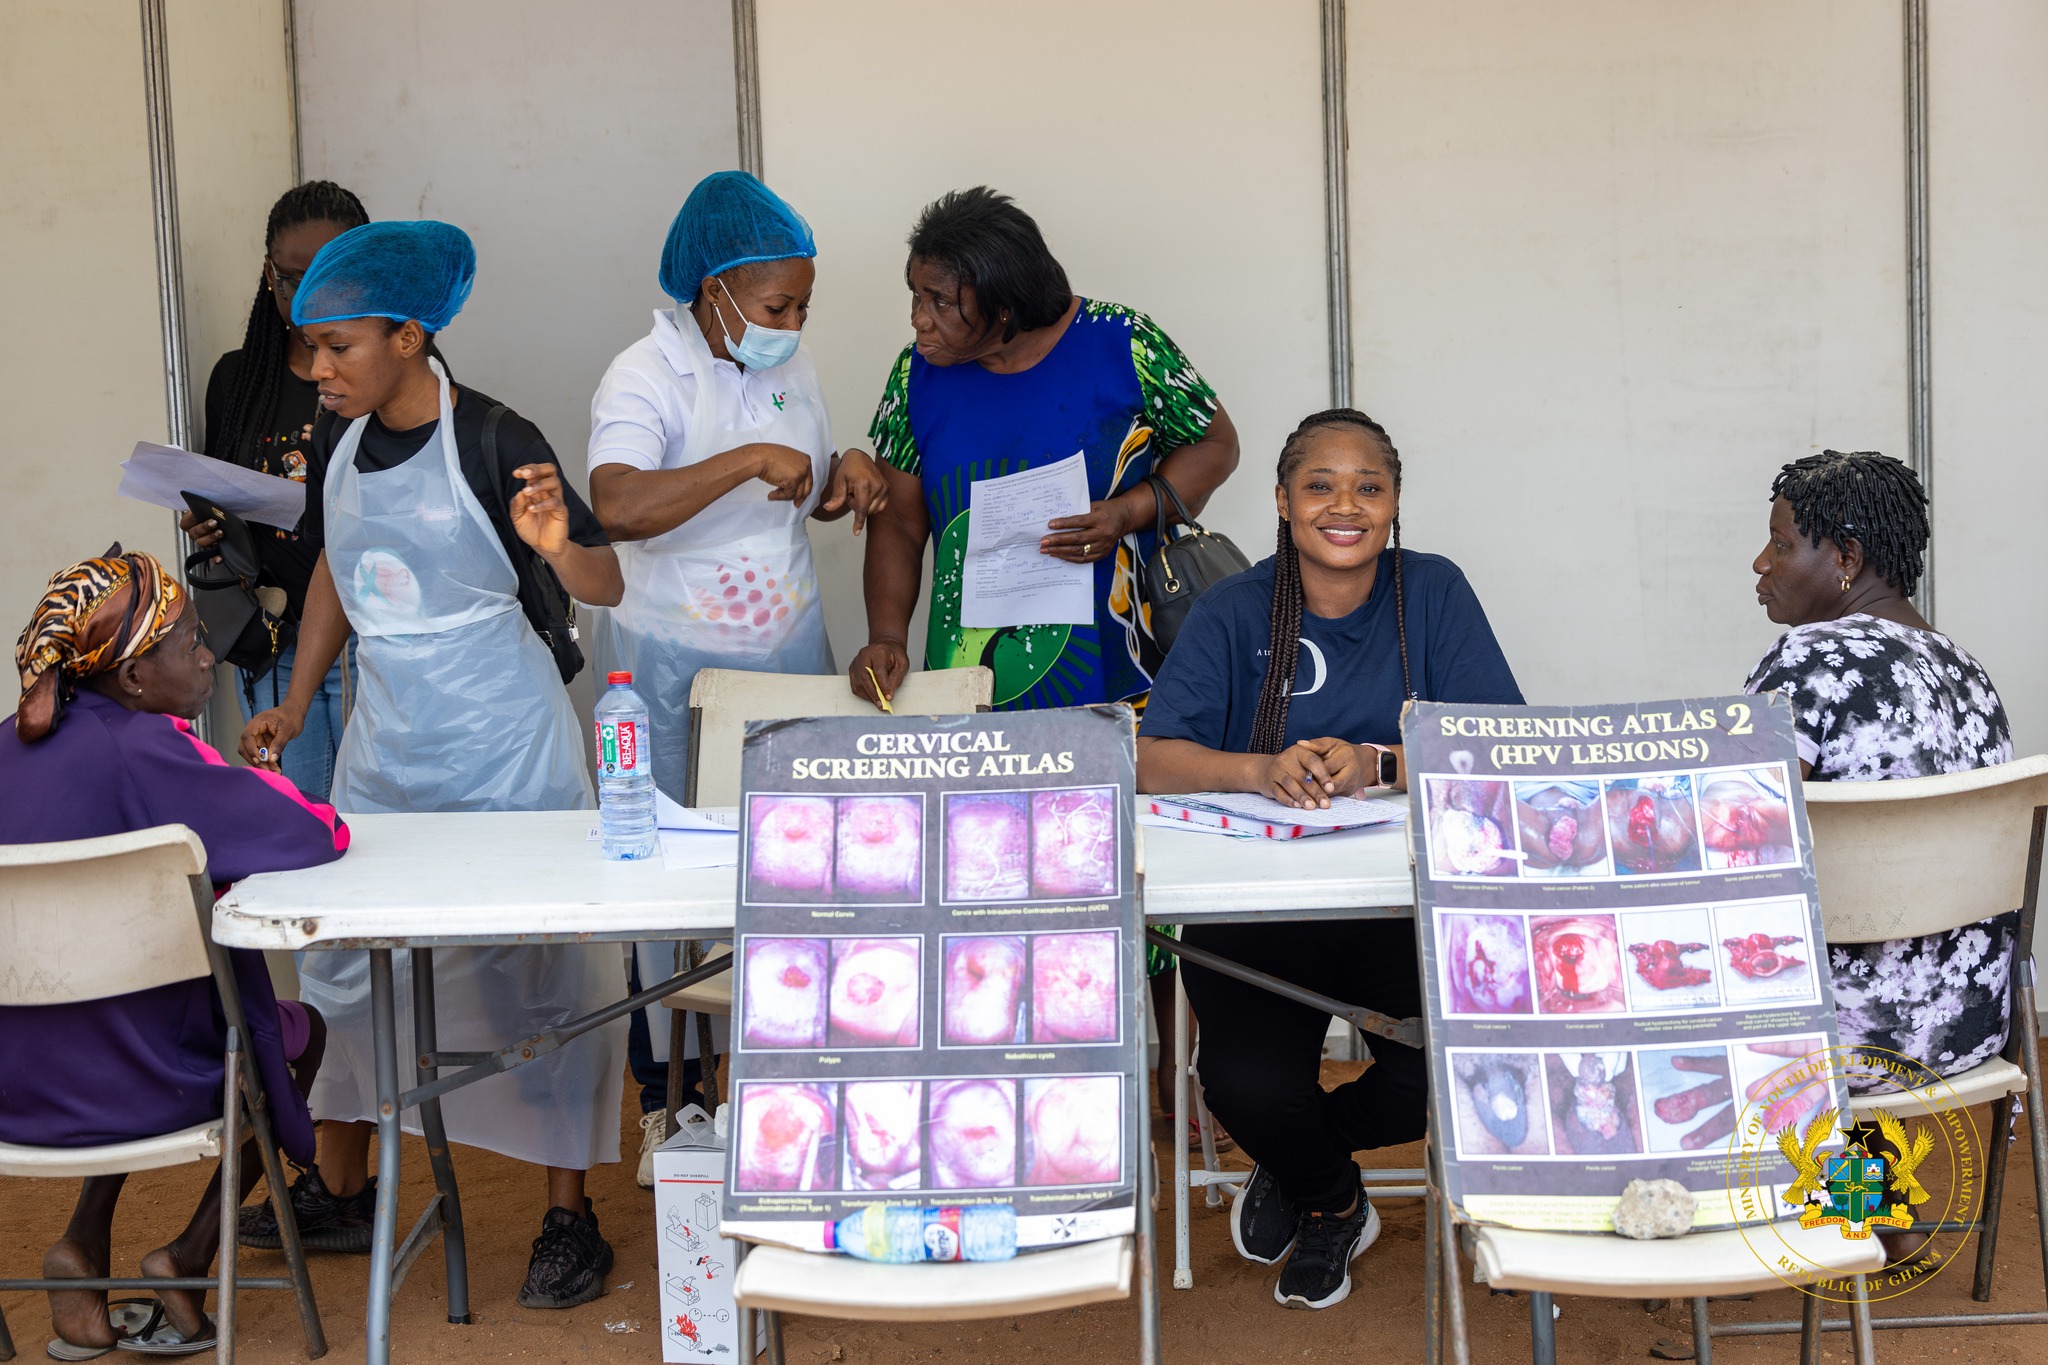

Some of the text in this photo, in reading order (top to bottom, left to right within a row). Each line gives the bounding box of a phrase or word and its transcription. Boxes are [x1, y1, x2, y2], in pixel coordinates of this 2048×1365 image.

[1440, 703, 1754, 738] SCREENING ATLAS 2
[856, 731, 1011, 756] CERVICAL
[1490, 738, 1711, 769] (HPV LESIONS)
[792, 752, 1075, 780] SCREENING ATLAS
[973, 908, 986, 916] with
[987, 907, 1022, 916] Intrauterine
[1023, 905, 1066, 914] Contraceptive
[930, 1198, 976, 1206] Transformation
[976, 1197, 992, 1205] Zone
[993, 1196, 1008, 1206] Type
[1030, 1194, 1075, 1202] Transformation
[1092, 1192, 1107, 1201] Type
[790, 1204, 807, 1212] Zone
[808, 1204, 824, 1213] Type
[902, 1199, 917, 1208] Type
